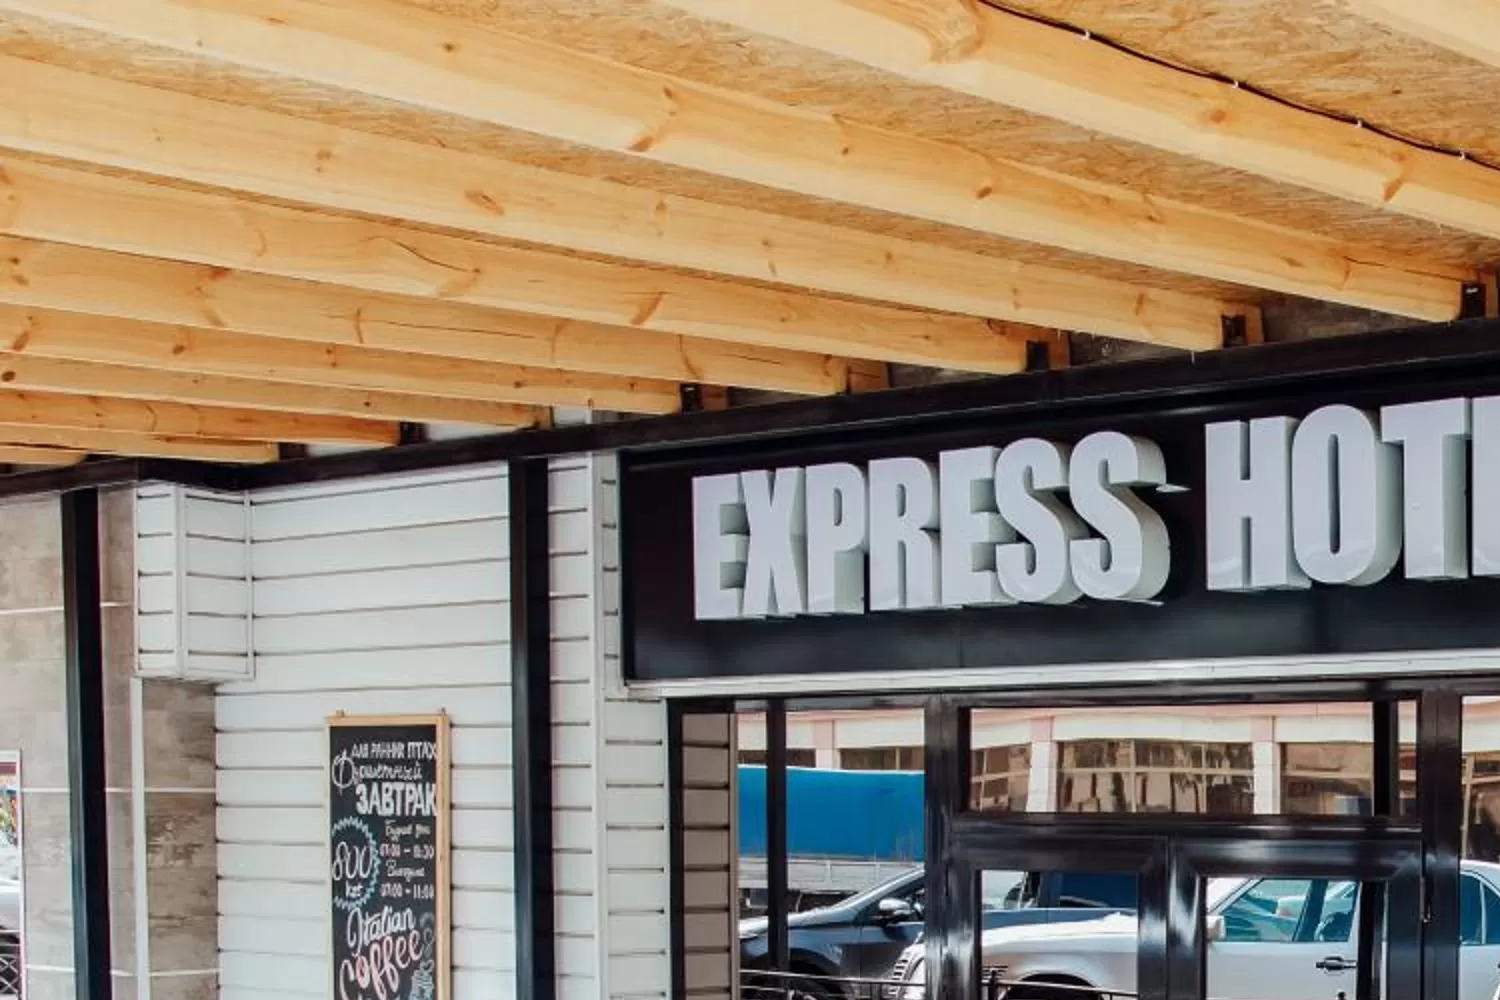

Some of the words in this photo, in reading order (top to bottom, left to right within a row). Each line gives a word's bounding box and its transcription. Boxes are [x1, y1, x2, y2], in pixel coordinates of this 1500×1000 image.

[692, 430, 1172, 620] EXPRESS
[355, 781, 438, 817] ЗАВТРАК
[331, 841, 373, 881] 800
[347, 905, 416, 958] Italian
